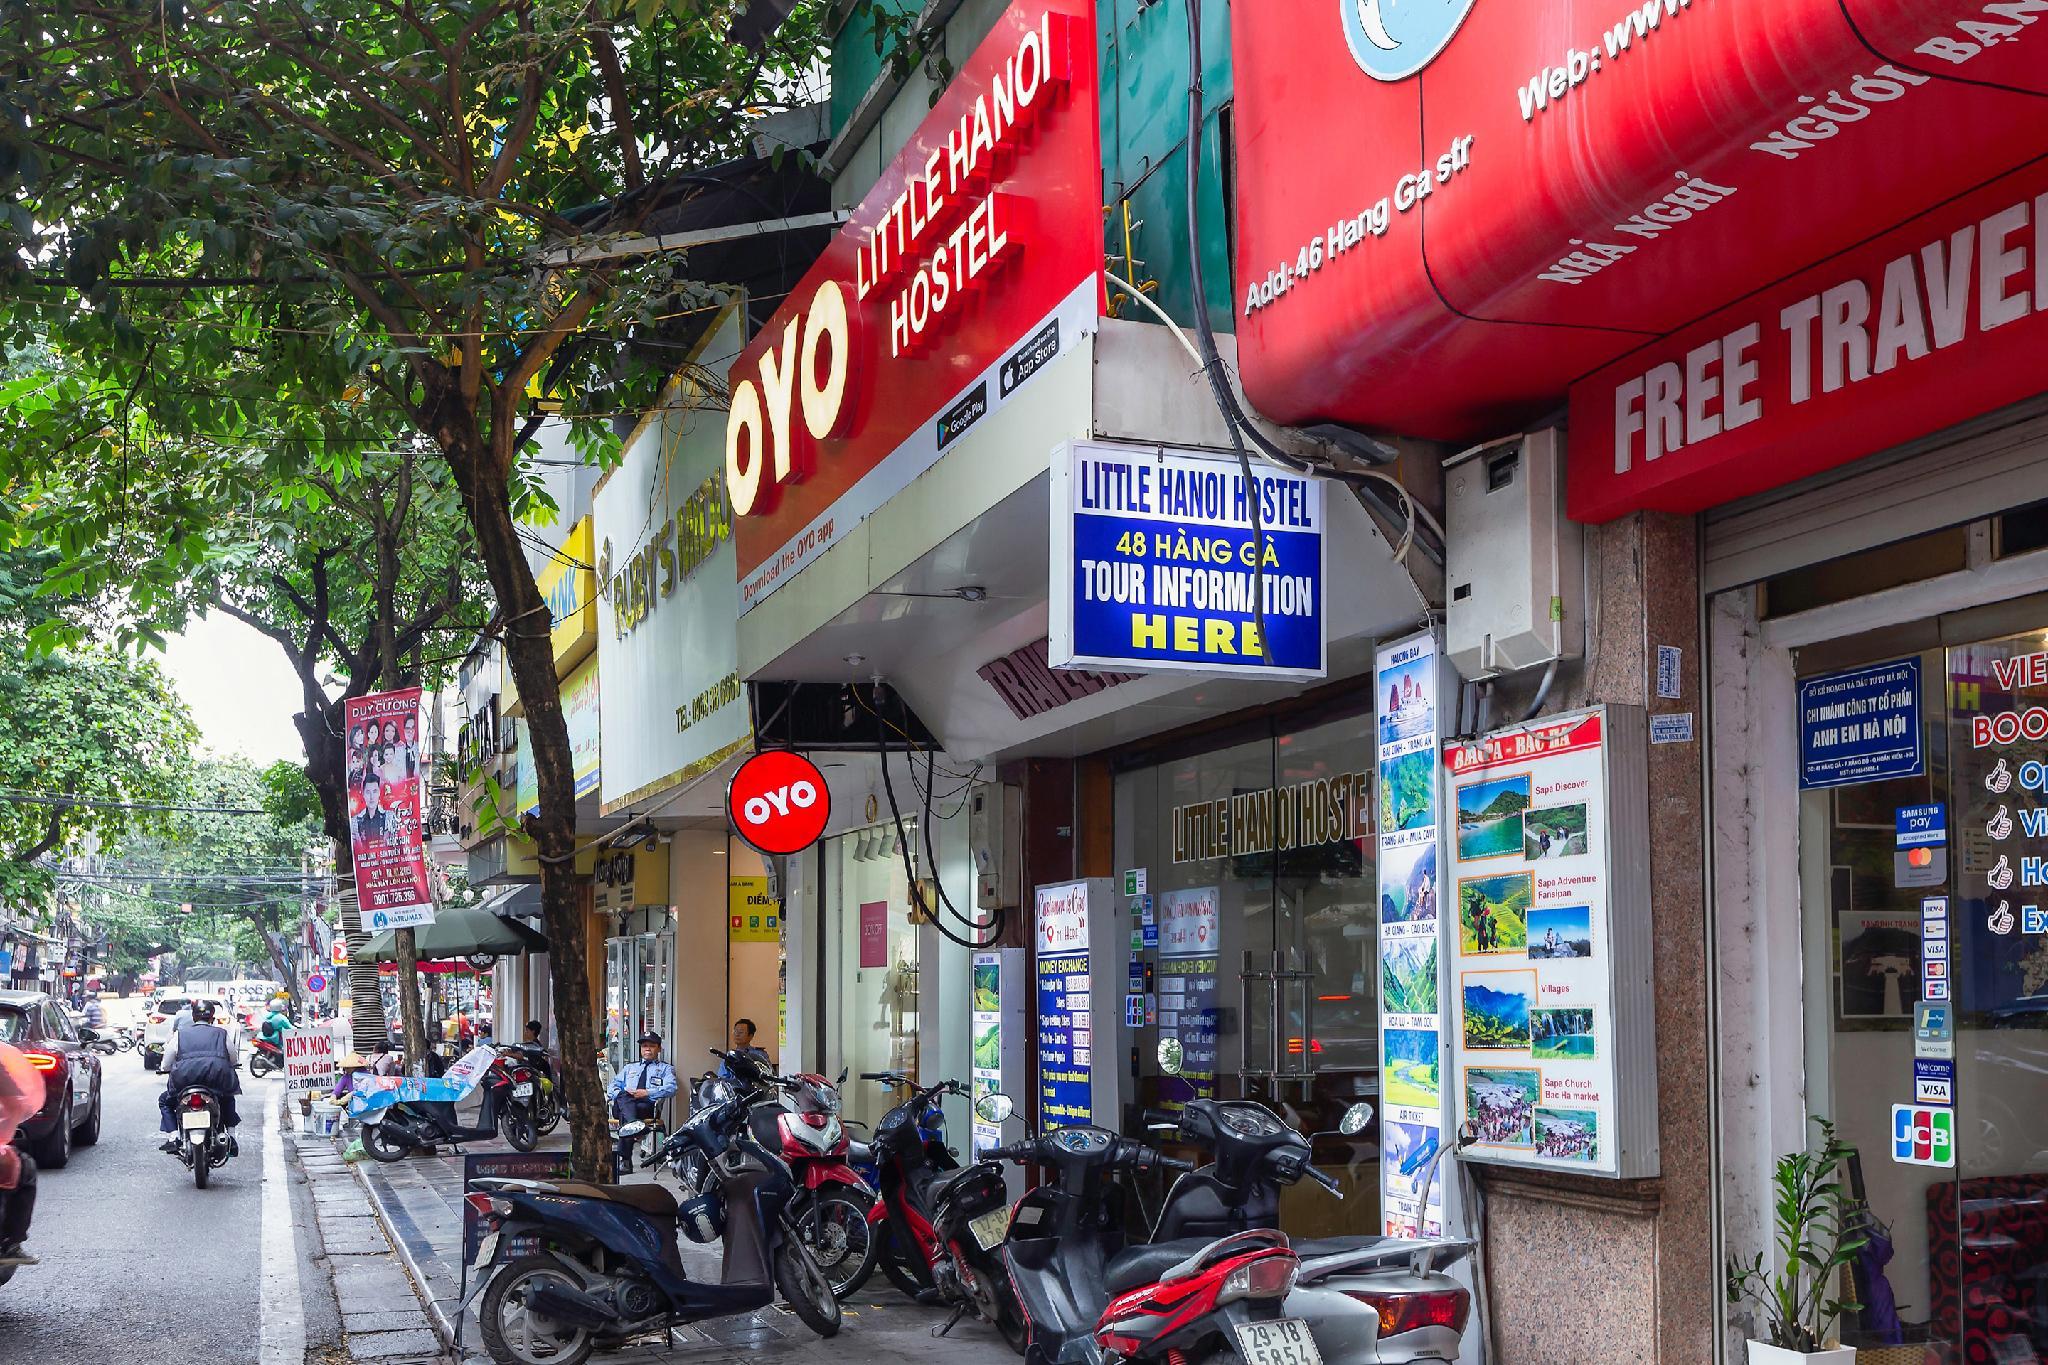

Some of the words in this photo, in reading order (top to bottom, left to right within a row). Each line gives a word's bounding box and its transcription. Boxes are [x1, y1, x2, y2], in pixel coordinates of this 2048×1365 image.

[1518, 45, 1602, 120] Web:
[856, 148, 943, 301] LITTLE
[948, 10, 1051, 194] HANOI
[1327, 197, 1390, 260] Hang
[1394, 169, 1432, 212] Ga
[1436, 134, 1474, 182] str
[1536, 238, 1638, 285] NHÀ
[1613, 170, 1738, 239] NGHỈ
[891, 191, 1007, 358] HOSTEL
[1018, 360, 1034, 380] App
[1035, 340, 1056, 364] Store
[726, 280, 848, 516] OYO
[1614, 322, 1762, 475] FREE
[951, 410, 972, 432] Google
[972, 400, 984, 416] Play
[1081, 460, 1150, 514] LITTLE
[1159, 468, 1226, 521] HANOI
[743, 559, 780, 602] Download
[782, 551, 795, 572] the
[797, 530, 815, 559] OYO
[817, 518, 834, 543] app
[1115, 531, 1147, 557] 48
[1155, 527, 1233, 565] HÀNG
[1239, 534, 1280, 569] GÀ
[544, 567, 578, 631] ANK
[1081, 559, 1146, 605] TOUR
[1153, 564, 1313, 617] INFORMATION
[1131, 613, 1267, 657] HERE
[1991, 650, 2048, 691] VIE
[352, 704, 374, 718] DUY
[1807, 708, 1819, 724] CHI
[1846, 698, 1867, 717] CÔNG
[1868, 697, 1877, 713] TY
[1812, 728, 1838, 749] ANH
[1841, 723, 1860, 744] EM
[1863, 718, 1881, 740] HÀ
[1884, 713, 1907, 739] NỘI
[1535, 784, 1553, 797] Sapa
[1555, 778, 1589, 792] Discover
[744, 780, 817, 825] OYO
[1173, 798, 1228, 864] LITTLE
[1232, 784, 1297, 856] HANOI
[1300, 768, 1376, 848] HOSTEL
[1901, 806, 1939, 819] SAMSUNG
[1910, 816, 1931, 830] pay
[1538, 878, 1557, 889] Sapa
[1557, 874, 1597, 886] Adventure
[1538, 889, 1572, 900] Fansipan
[1927, 945, 1945, 954] VISA
[1040, 960, 1058, 974] MONEY
[1058, 957, 1088, 973] EXCHANGE
[1541, 984, 1570, 995] Villages
[1411, 1016, 1423, 1028] TAM
[285, 1031, 307, 1058] BÚN
[309, 1034, 332, 1058] MỌC
[1916, 1062, 1950, 1073] Welcome
[1544, 1078, 1563, 1089] Sapa
[1564, 1077, 1592, 1089] Church
[1545, 1090, 1560, 1100] Bac
[1561, 1091, 1571, 1100] Ha
[1573, 1091, 1600, 1102] market
[1921, 1084, 1947, 1097] VISA
[1400, 1110, 1409, 1121] AIR
[1895, 1125, 1949, 1146] JCB
[1398, 1201, 1413, 1213] TRAIN
[1247, 1321, 1301, 1349] 29-Y8
